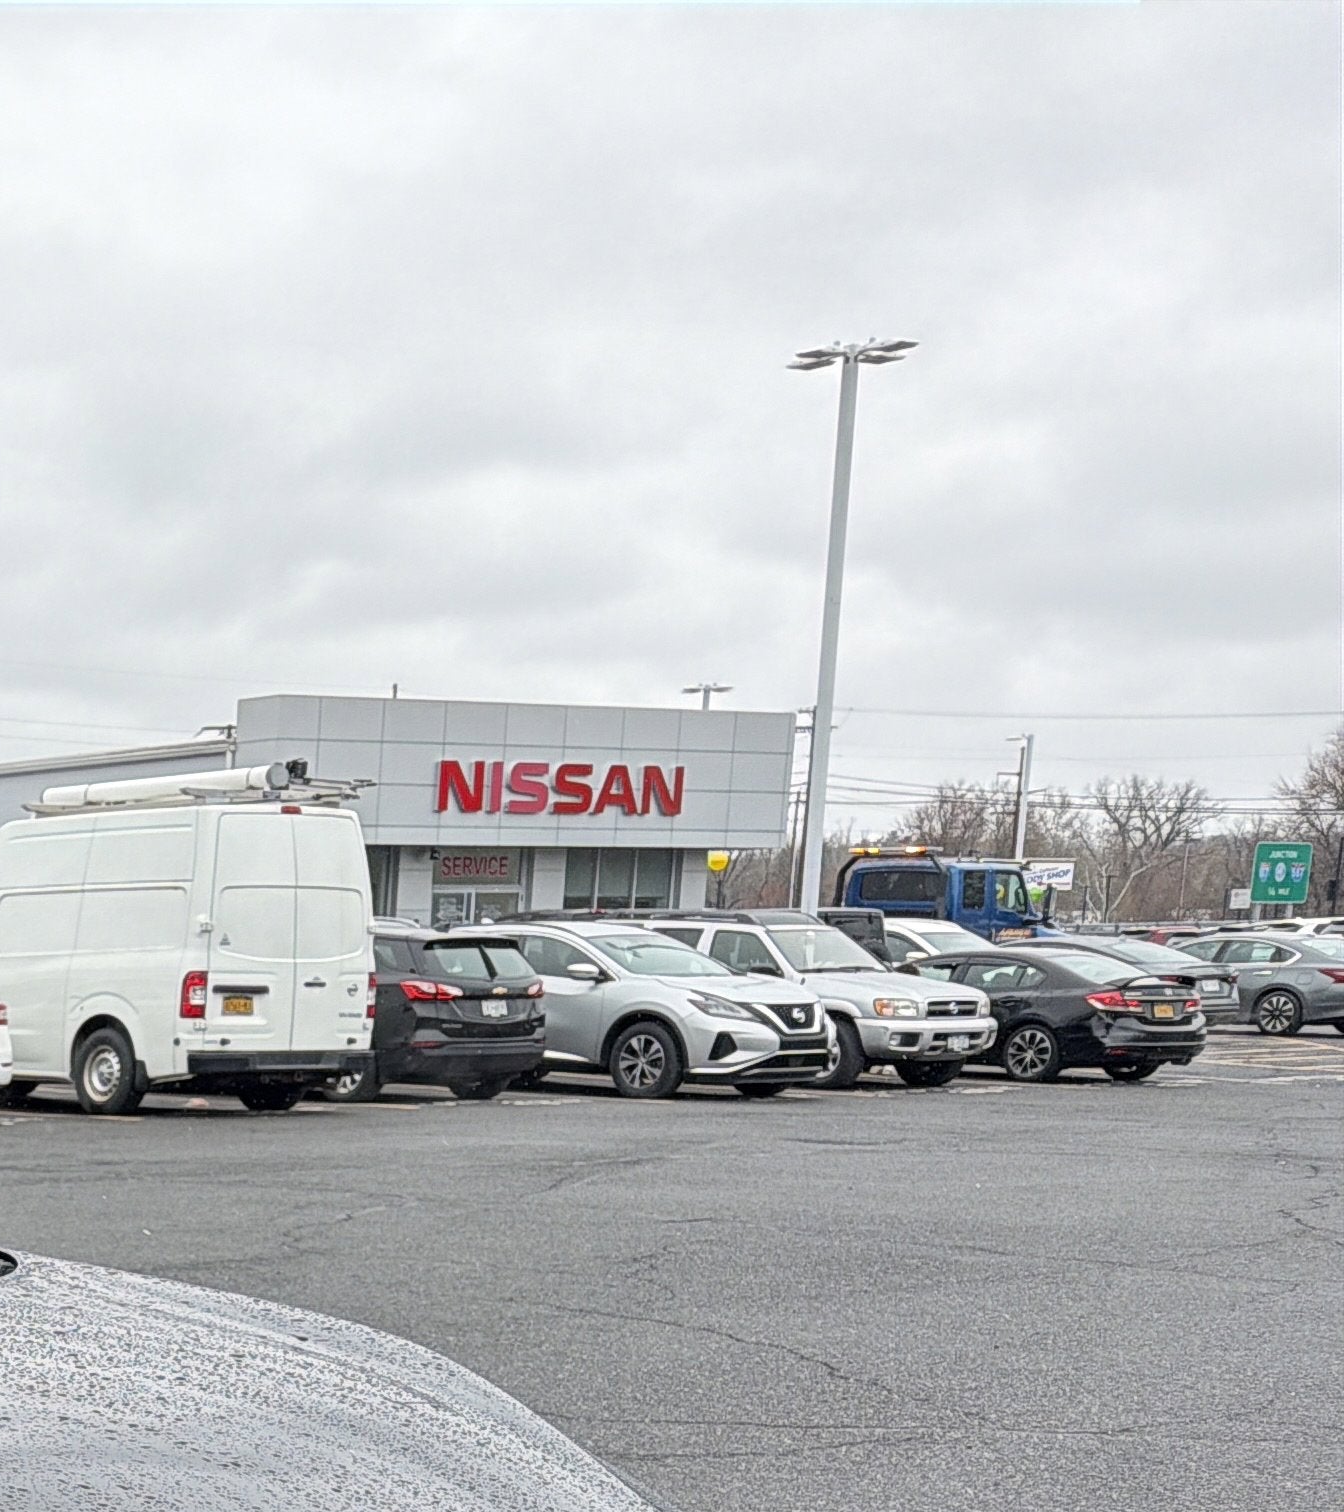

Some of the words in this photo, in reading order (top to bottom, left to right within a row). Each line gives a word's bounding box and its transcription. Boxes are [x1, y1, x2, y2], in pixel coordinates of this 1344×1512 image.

[436, 760, 685, 816] NISSAN
[441, 856, 509, 876] SERVICE
[1046, 868, 1071, 881] SHOP
